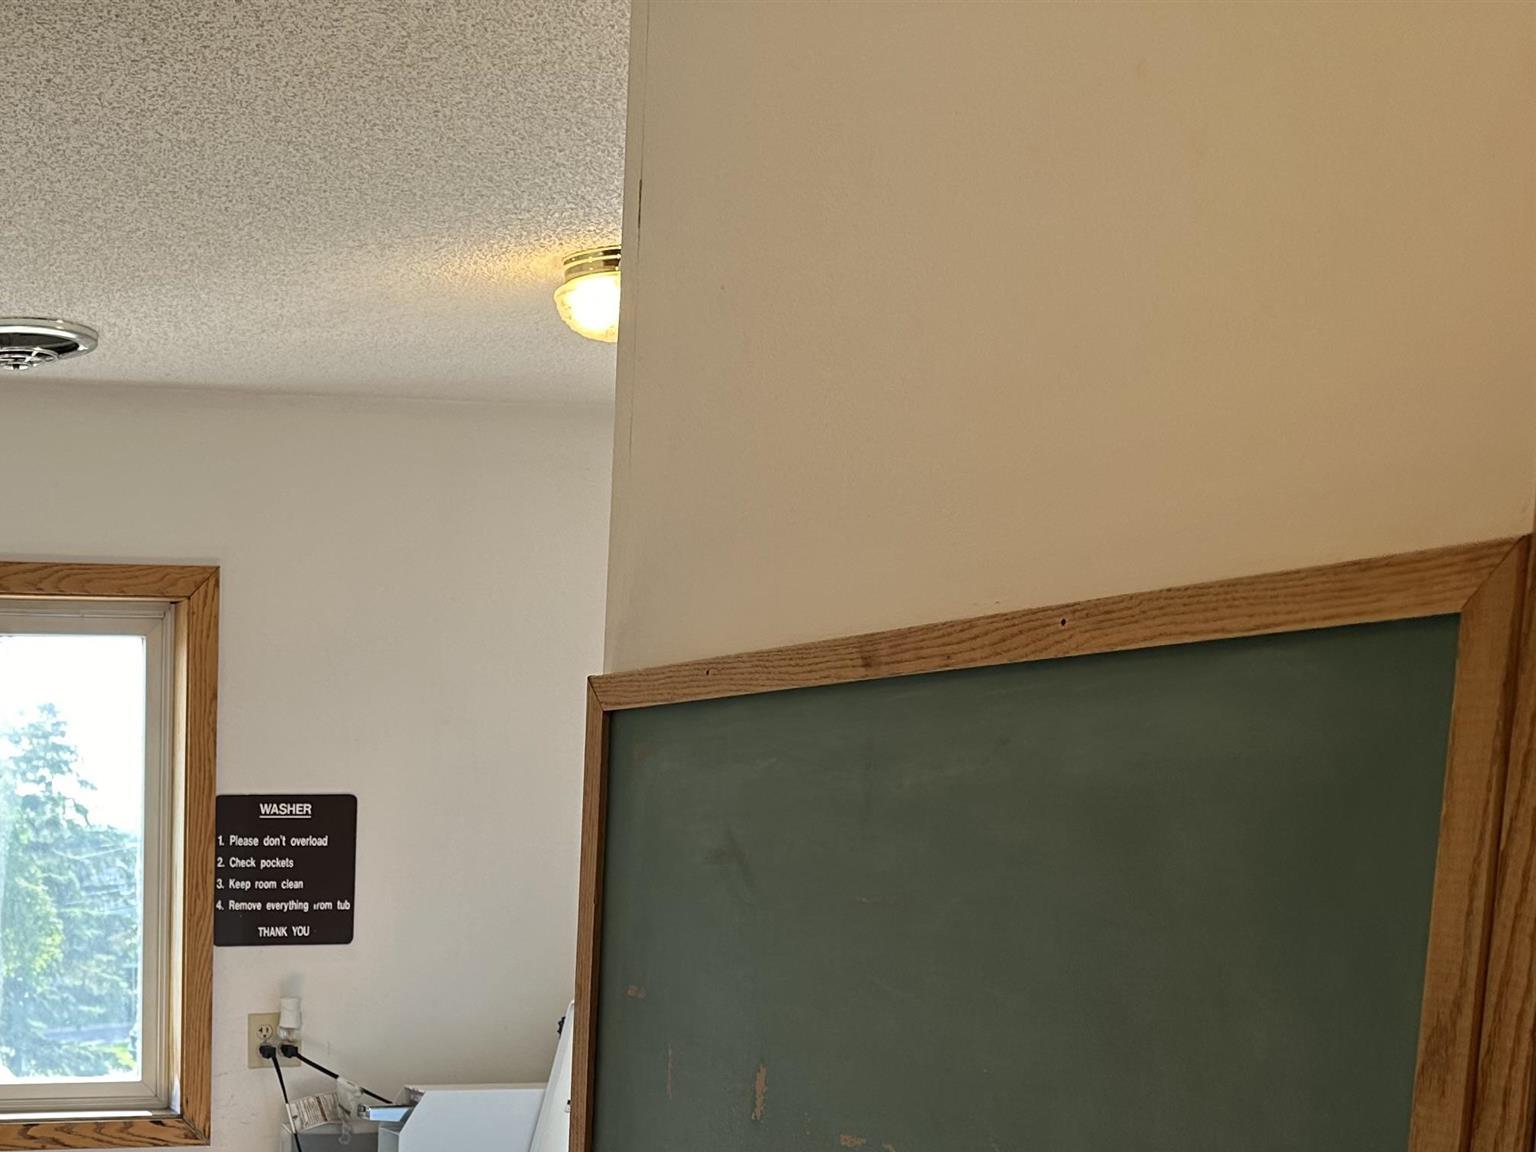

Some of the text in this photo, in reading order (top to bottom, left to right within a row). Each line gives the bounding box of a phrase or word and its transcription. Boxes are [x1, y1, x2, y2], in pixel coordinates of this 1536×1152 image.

[259, 803, 312, 814] WASHER
[218, 835, 328, 846] 1. Please don't overload
[217, 857, 294, 869] 2. Check pockets
[217, 879, 303, 891] 3. Keep room clean
[216, 901, 224, 910] 4.
[229, 901, 262, 910] Remove
[266, 900, 308, 912] everything
[337, 900, 350, 910] tub
[258, 926, 310, 937] THANK YOU
